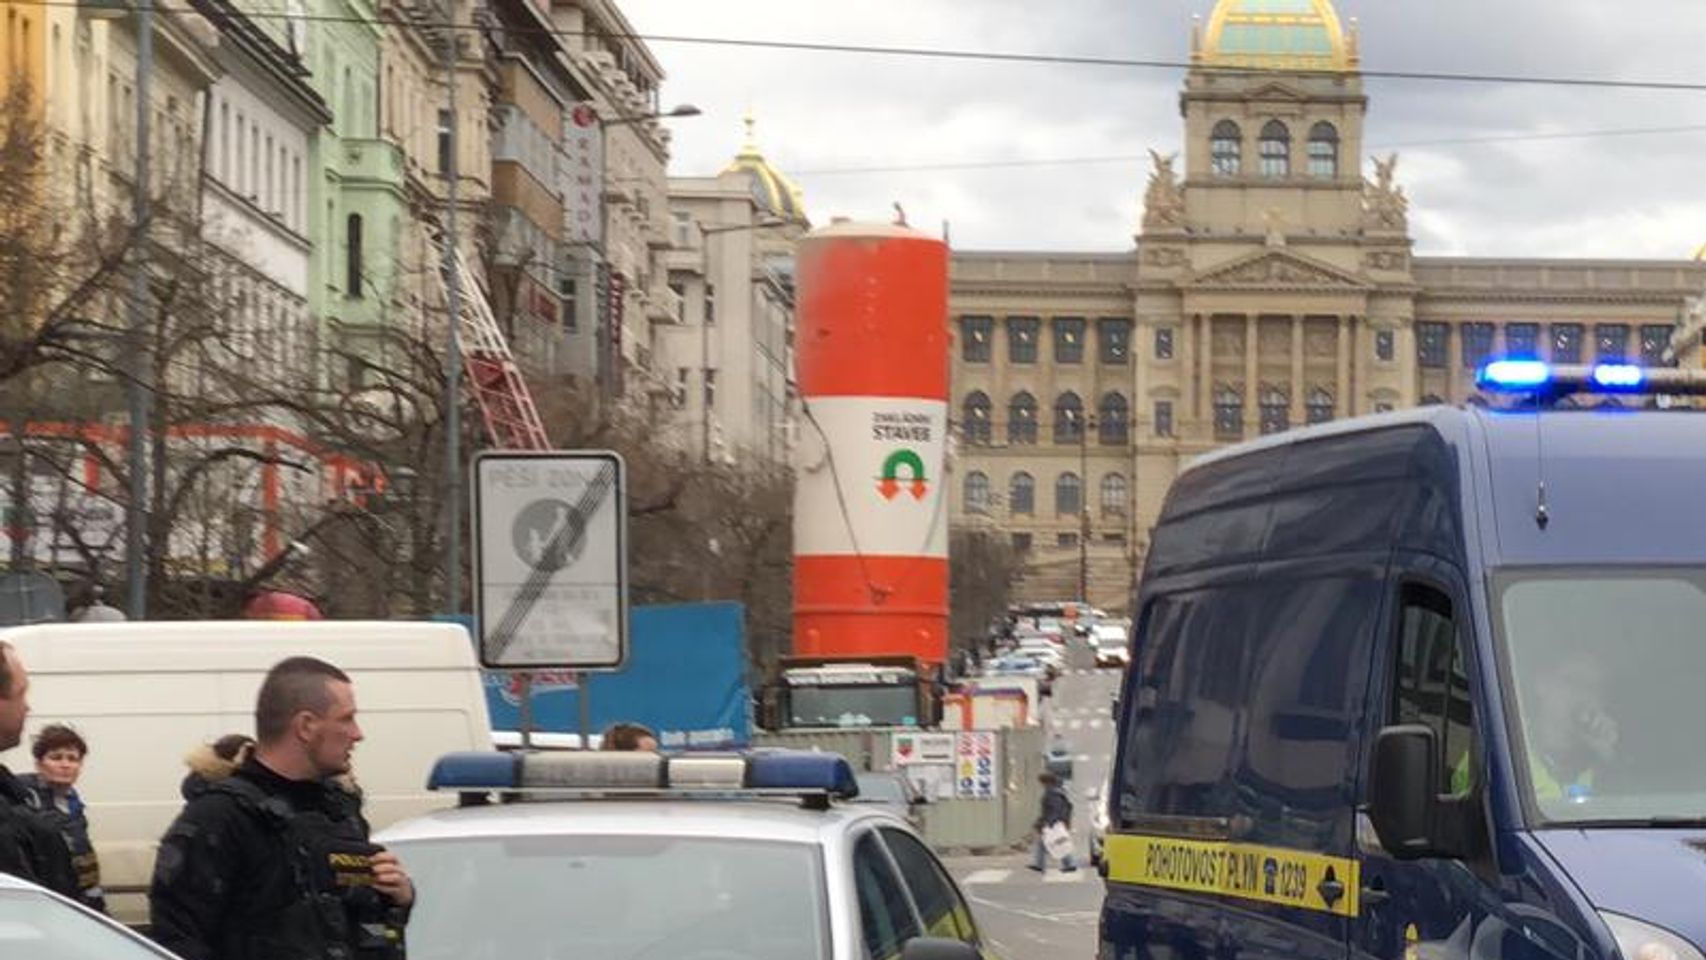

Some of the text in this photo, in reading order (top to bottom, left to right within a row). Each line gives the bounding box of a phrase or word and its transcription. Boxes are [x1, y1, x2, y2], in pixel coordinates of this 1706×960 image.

[1145, 842, 1307, 899] POHOTOVOST PLYN 1239
